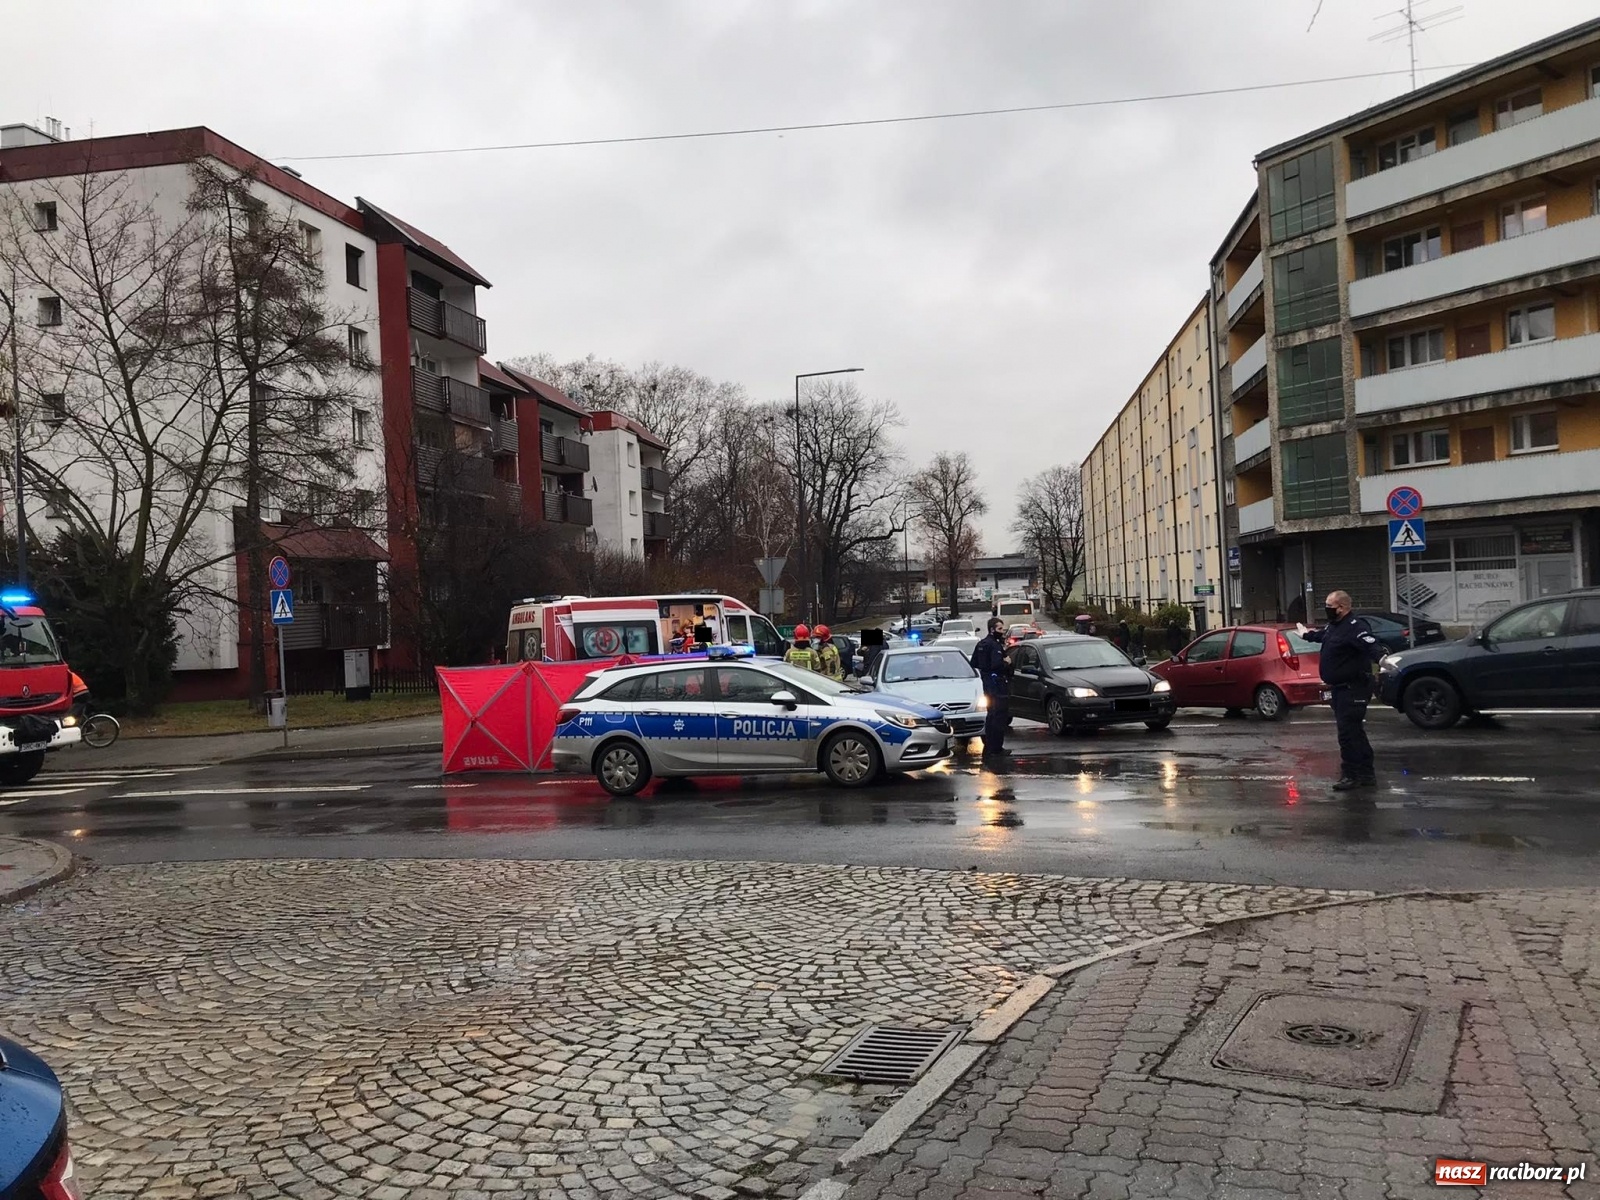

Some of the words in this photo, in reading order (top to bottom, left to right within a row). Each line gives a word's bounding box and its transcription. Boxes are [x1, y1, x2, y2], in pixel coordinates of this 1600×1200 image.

[1459, 581, 1514, 590] RACHUNKOWE
[512, 610, 535, 625] AMBULANS
[579, 717, 593, 726] P111
[733, 719, 796, 737] POLICJA
